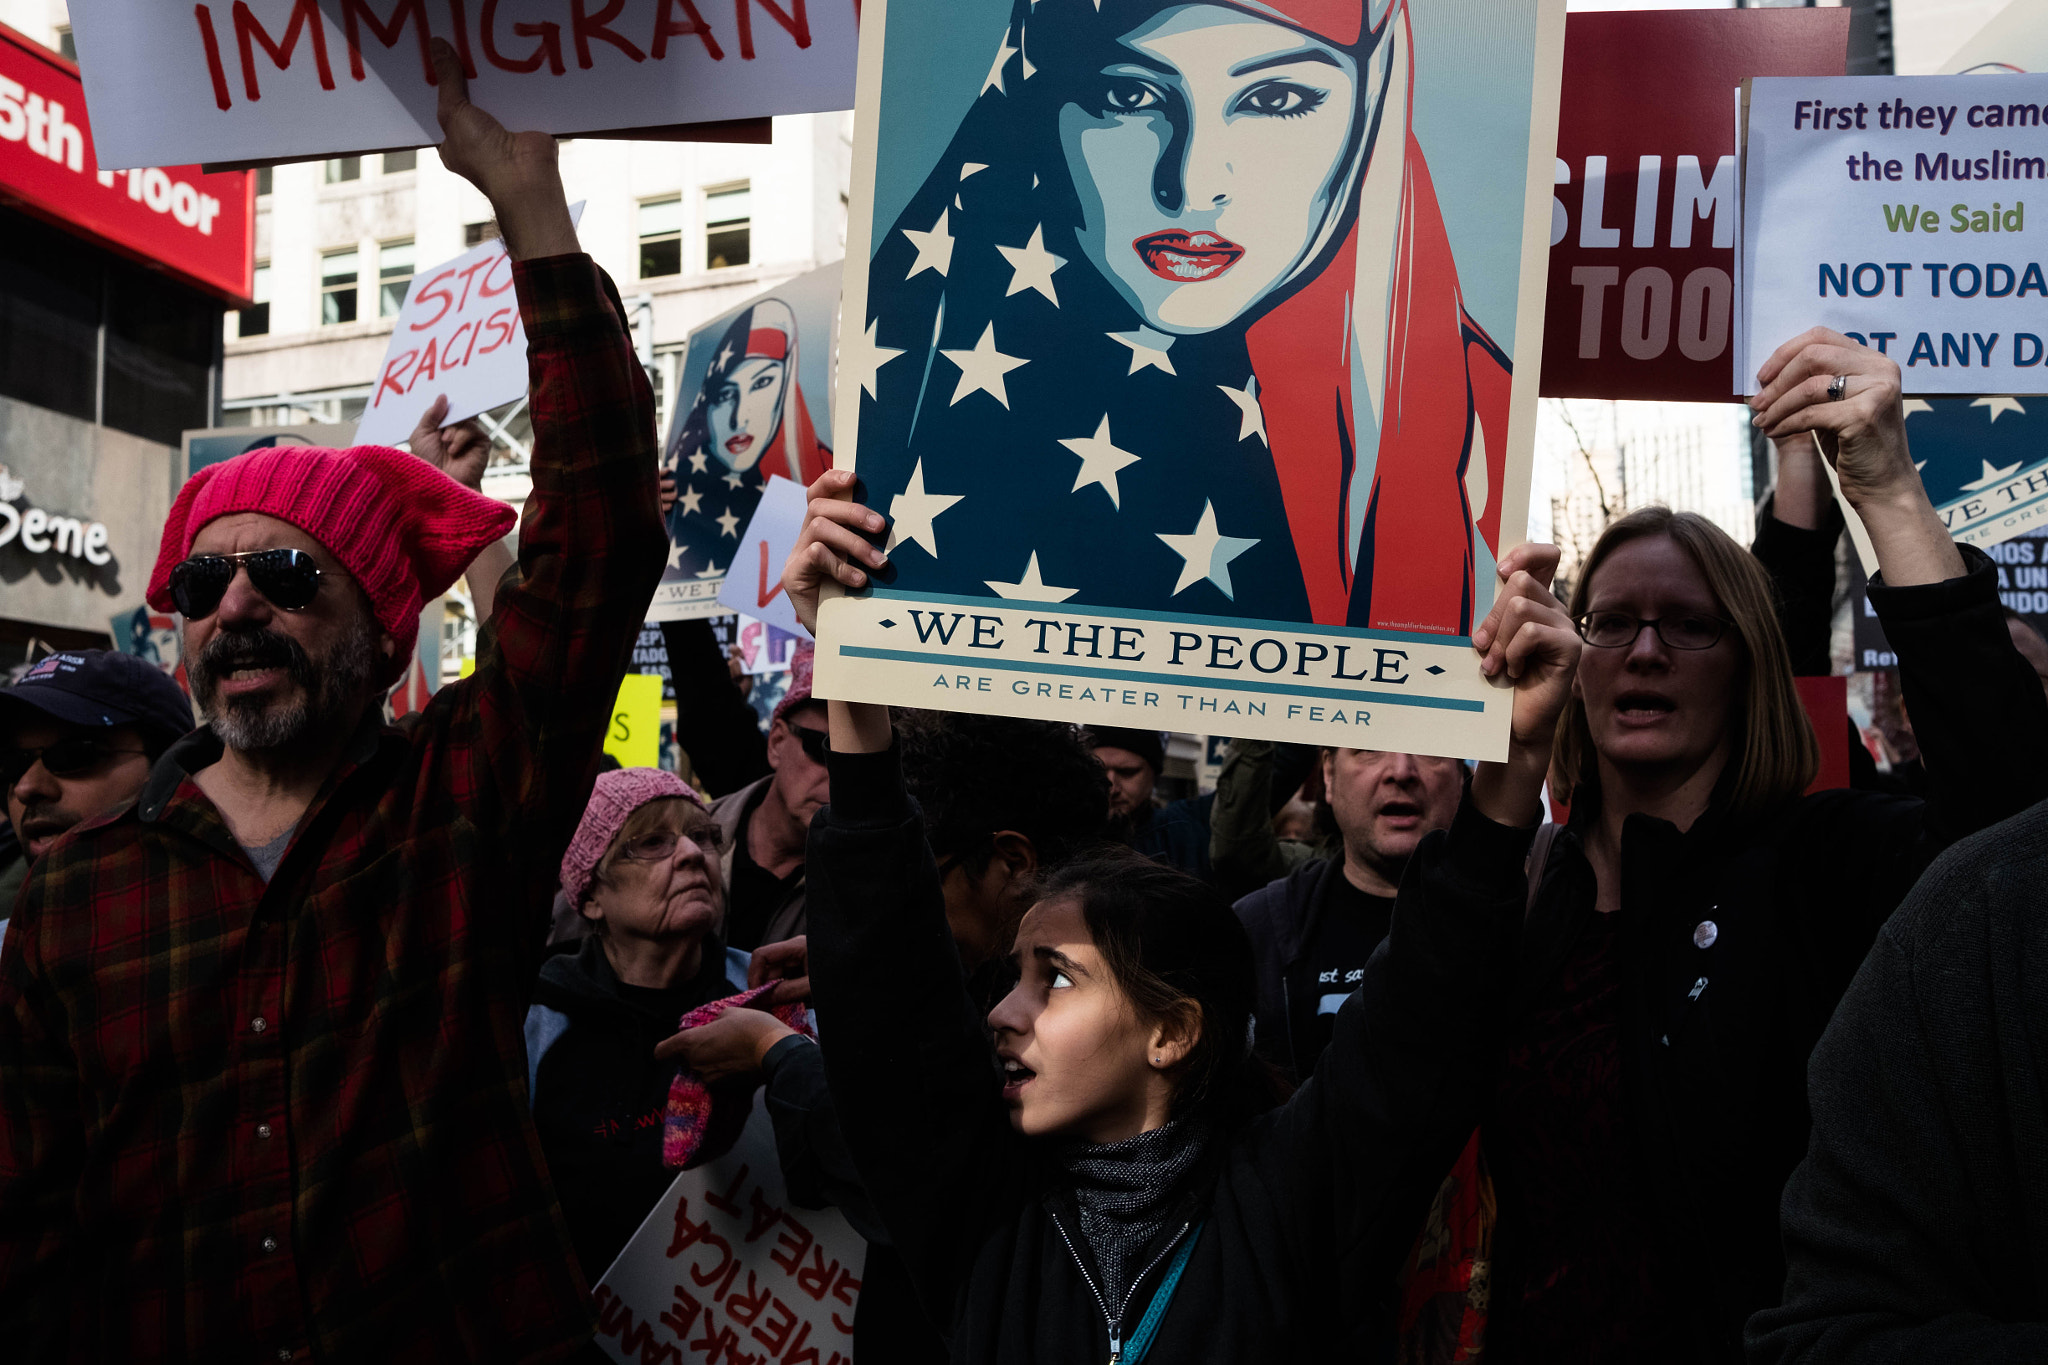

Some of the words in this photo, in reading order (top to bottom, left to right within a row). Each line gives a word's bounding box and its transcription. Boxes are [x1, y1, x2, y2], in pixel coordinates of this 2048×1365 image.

[194, 0, 861, 112] IMMIGRAN
[0, 74, 84, 174] 5th
[1794, 99, 1869, 131] First
[1877, 97, 1958, 136] they
[1846, 151, 1904, 181] the
[1914, 149, 2048, 182] Muslim
[1882, 203, 1941, 233] We
[1949, 201, 2025, 233] Said
[1818, 262, 1913, 298] NOT
[1922, 262, 2048, 298] TODA
[1571, 266, 1732, 361] TOO
[1907, 332, 2000, 367] ANY
[668, 583, 702, 599] WE
[907, 609, 1005, 650] WE
[1024, 618, 1146, 662] THE
[1166, 631, 1410, 684] PEOPLE
[933, 673, 993, 692] ARE
[1012, 680, 1160, 708] GREATER
[1177, 694, 1267, 717] THAN
[1287, 704, 1372, 727] FEAR
[665, 1196, 852, 1365] MERICA
[660, 1285, 766, 1365] AKE
